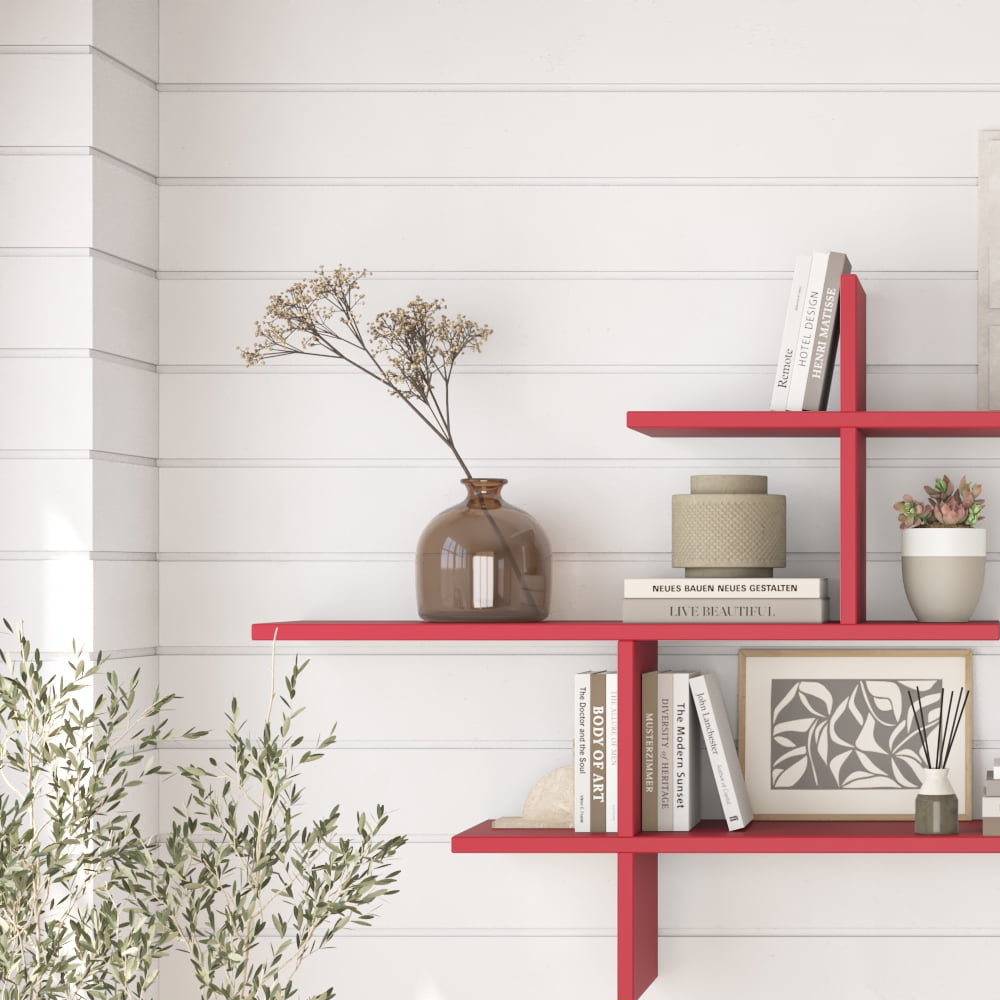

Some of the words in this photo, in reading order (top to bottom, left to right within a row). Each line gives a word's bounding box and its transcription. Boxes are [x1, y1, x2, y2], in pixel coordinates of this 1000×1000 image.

[804, 291, 819, 330] DESIGN
[798, 333, 812, 367] HOTEL
[812, 341, 826, 379] HENRI
[819, 288, 836, 338] MATISSE
[778, 348, 793, 388] Remote
[670, 606, 699, 617] LIVE
[703, 606, 776, 617] BEAUTIFUL
[593, 706, 604, 746] BODY
[661, 699, 669, 748] DIVERSITY
[676, 703, 685, 723] The
[696, 692, 706, 711] John
[702, 712, 718, 755] Lanchester
[593, 751, 604, 769] OF
[645, 713, 653, 793] MUSTERZIMMER
[676, 726, 685, 766] Modern
[593, 774, 604, 803] ART
[661, 762, 669, 809] HERITAGE
[676, 773, 685, 809] Sunset
